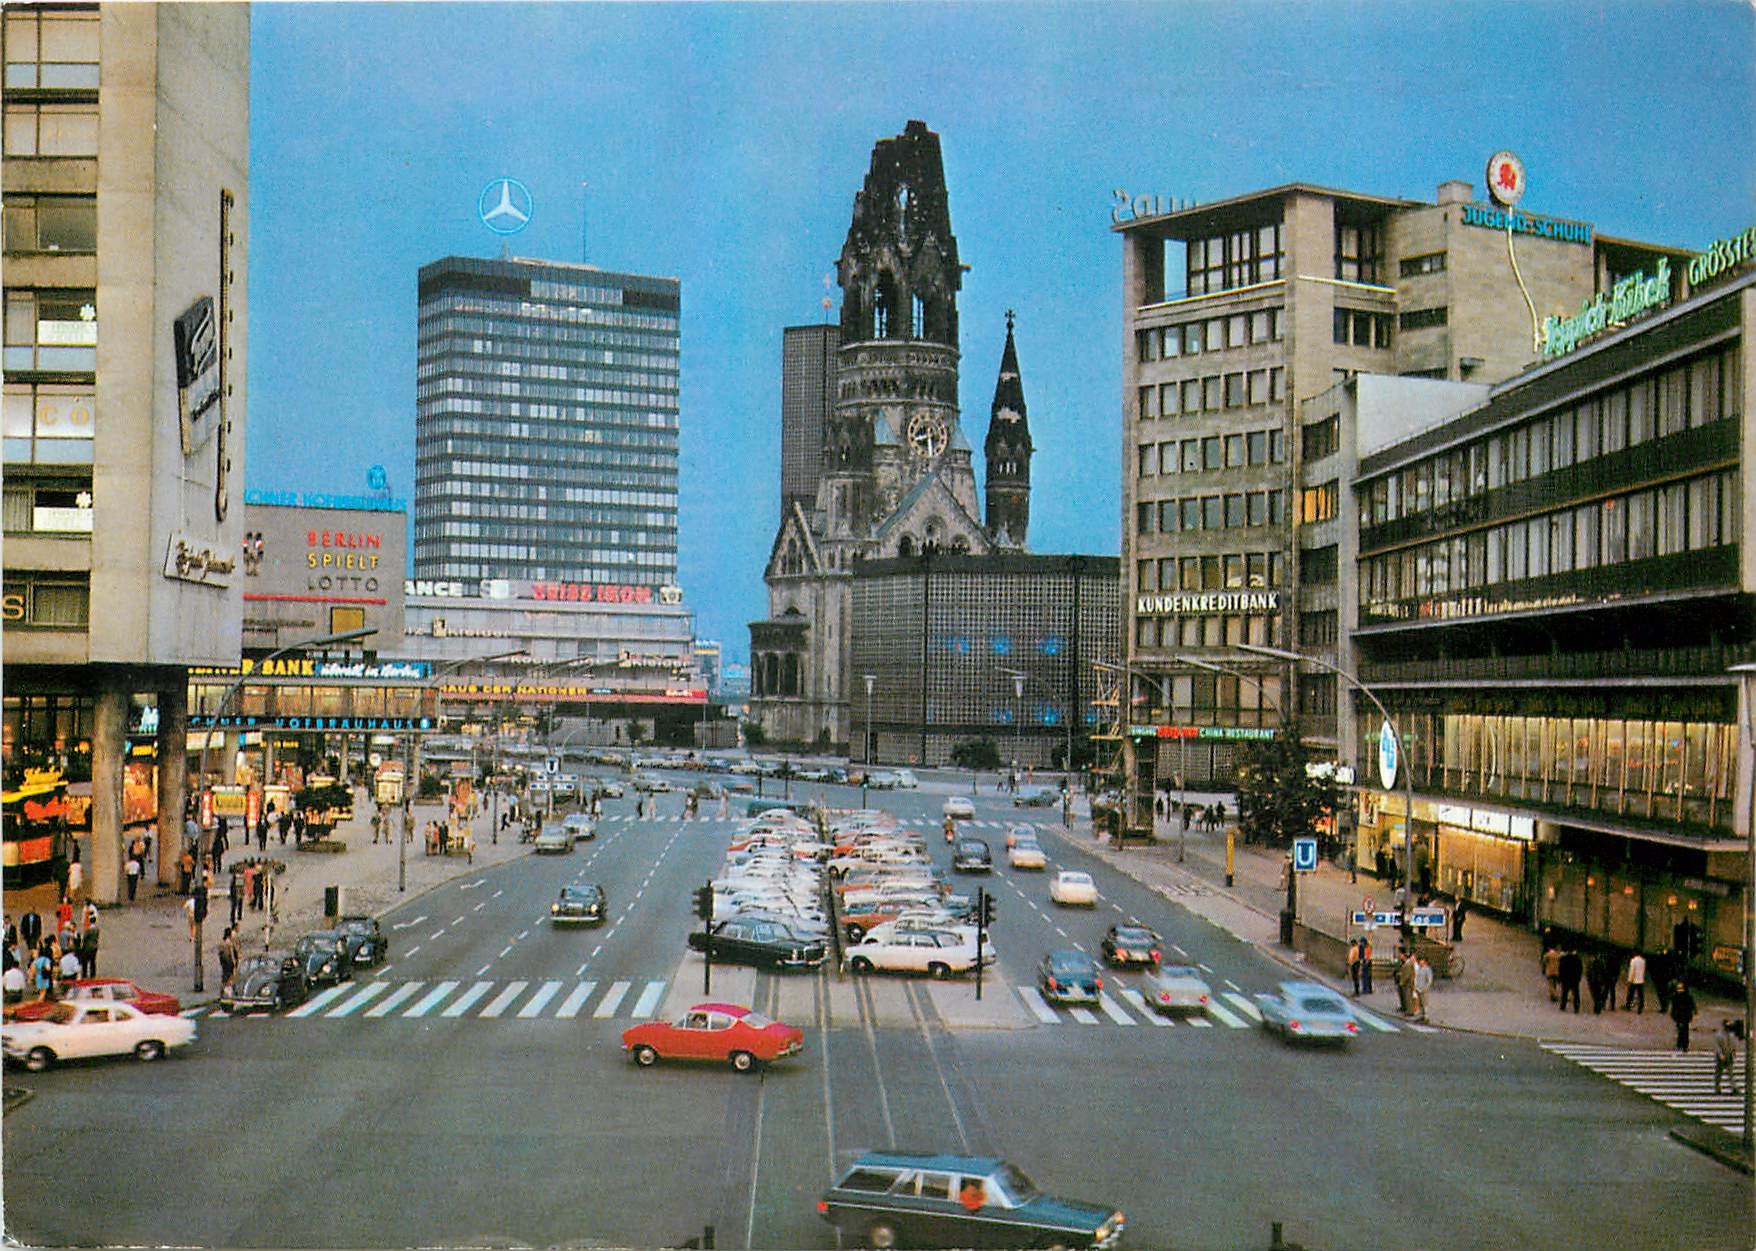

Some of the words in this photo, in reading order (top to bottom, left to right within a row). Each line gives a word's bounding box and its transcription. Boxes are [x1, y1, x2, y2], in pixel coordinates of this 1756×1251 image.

[307, 530, 382, 549] BERLIN
[307, 552, 381, 570] SPIELT
[307, 575, 379, 592] LOTTO
[1138, 591, 1279, 612] KUNDENKREDITBANK
[261, 659, 314, 676] BANK
[483, 685, 512, 694] DER
[517, 686, 588, 695] NATIONEN
[1298, 844, 1313, 866] U
